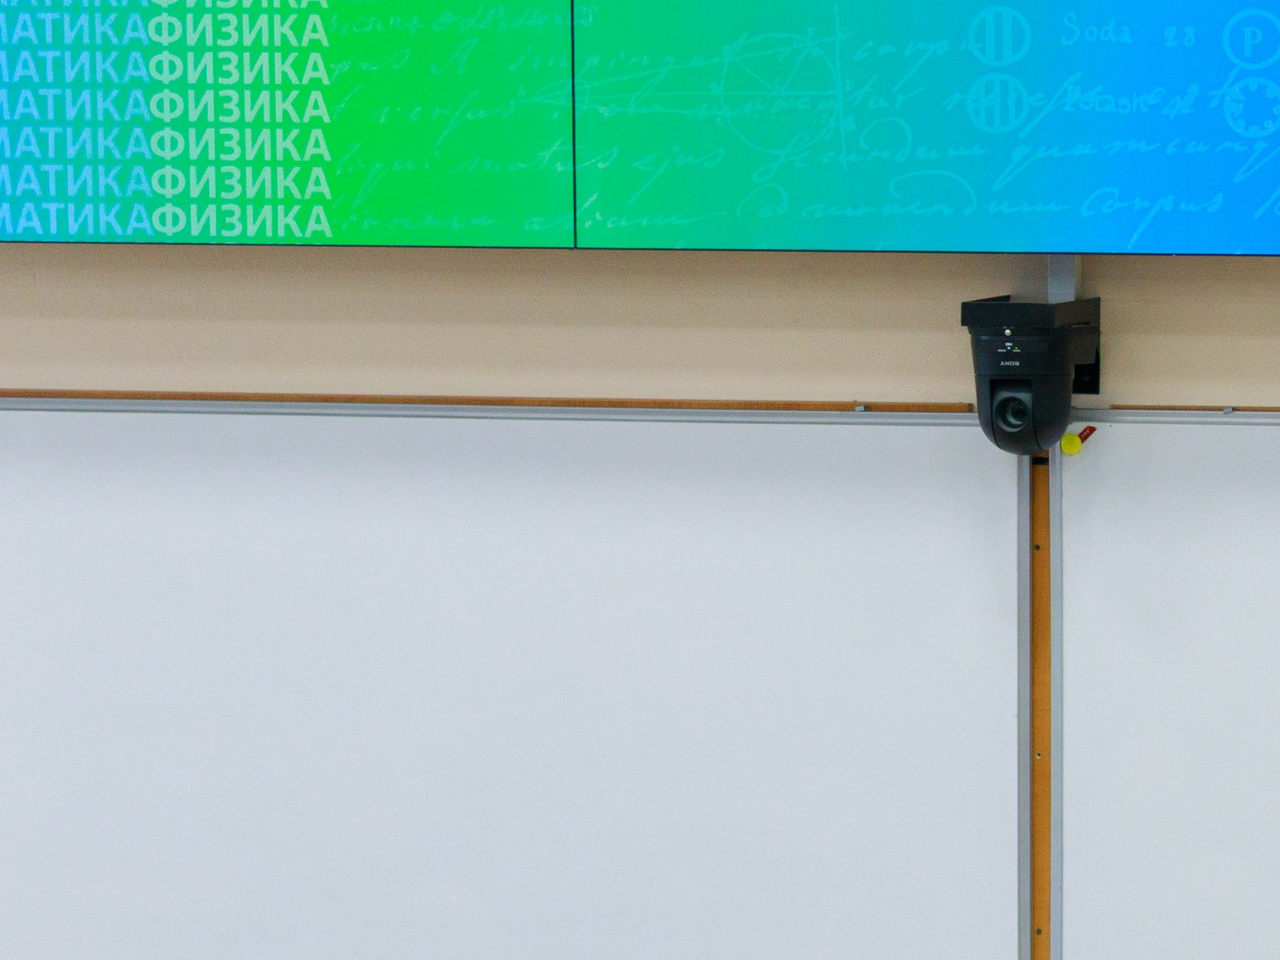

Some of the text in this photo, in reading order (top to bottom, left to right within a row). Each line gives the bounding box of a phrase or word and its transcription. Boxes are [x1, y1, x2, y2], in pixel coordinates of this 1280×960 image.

[0, 12, 148, 45] АТИКА
[148, 12, 330, 48] ФИЗИКА
[1061, 11, 1133, 47] Soda
[0, 50, 149, 83] АТИКА
[149, 50, 331, 86] ФИЗИКА
[0, 88, 151, 121] АТИКА
[150, 88, 331, 124] ФИЗИКА
[0, 126, 332, 162] АТИКА ФИЗИКА
[0, 164, 152, 197] АТИКА
[151, 164, 332, 200] ФИЗИКА
[0, 202, 154, 235] АТИКА
[152, 202, 333, 238] ФИЗИКА
